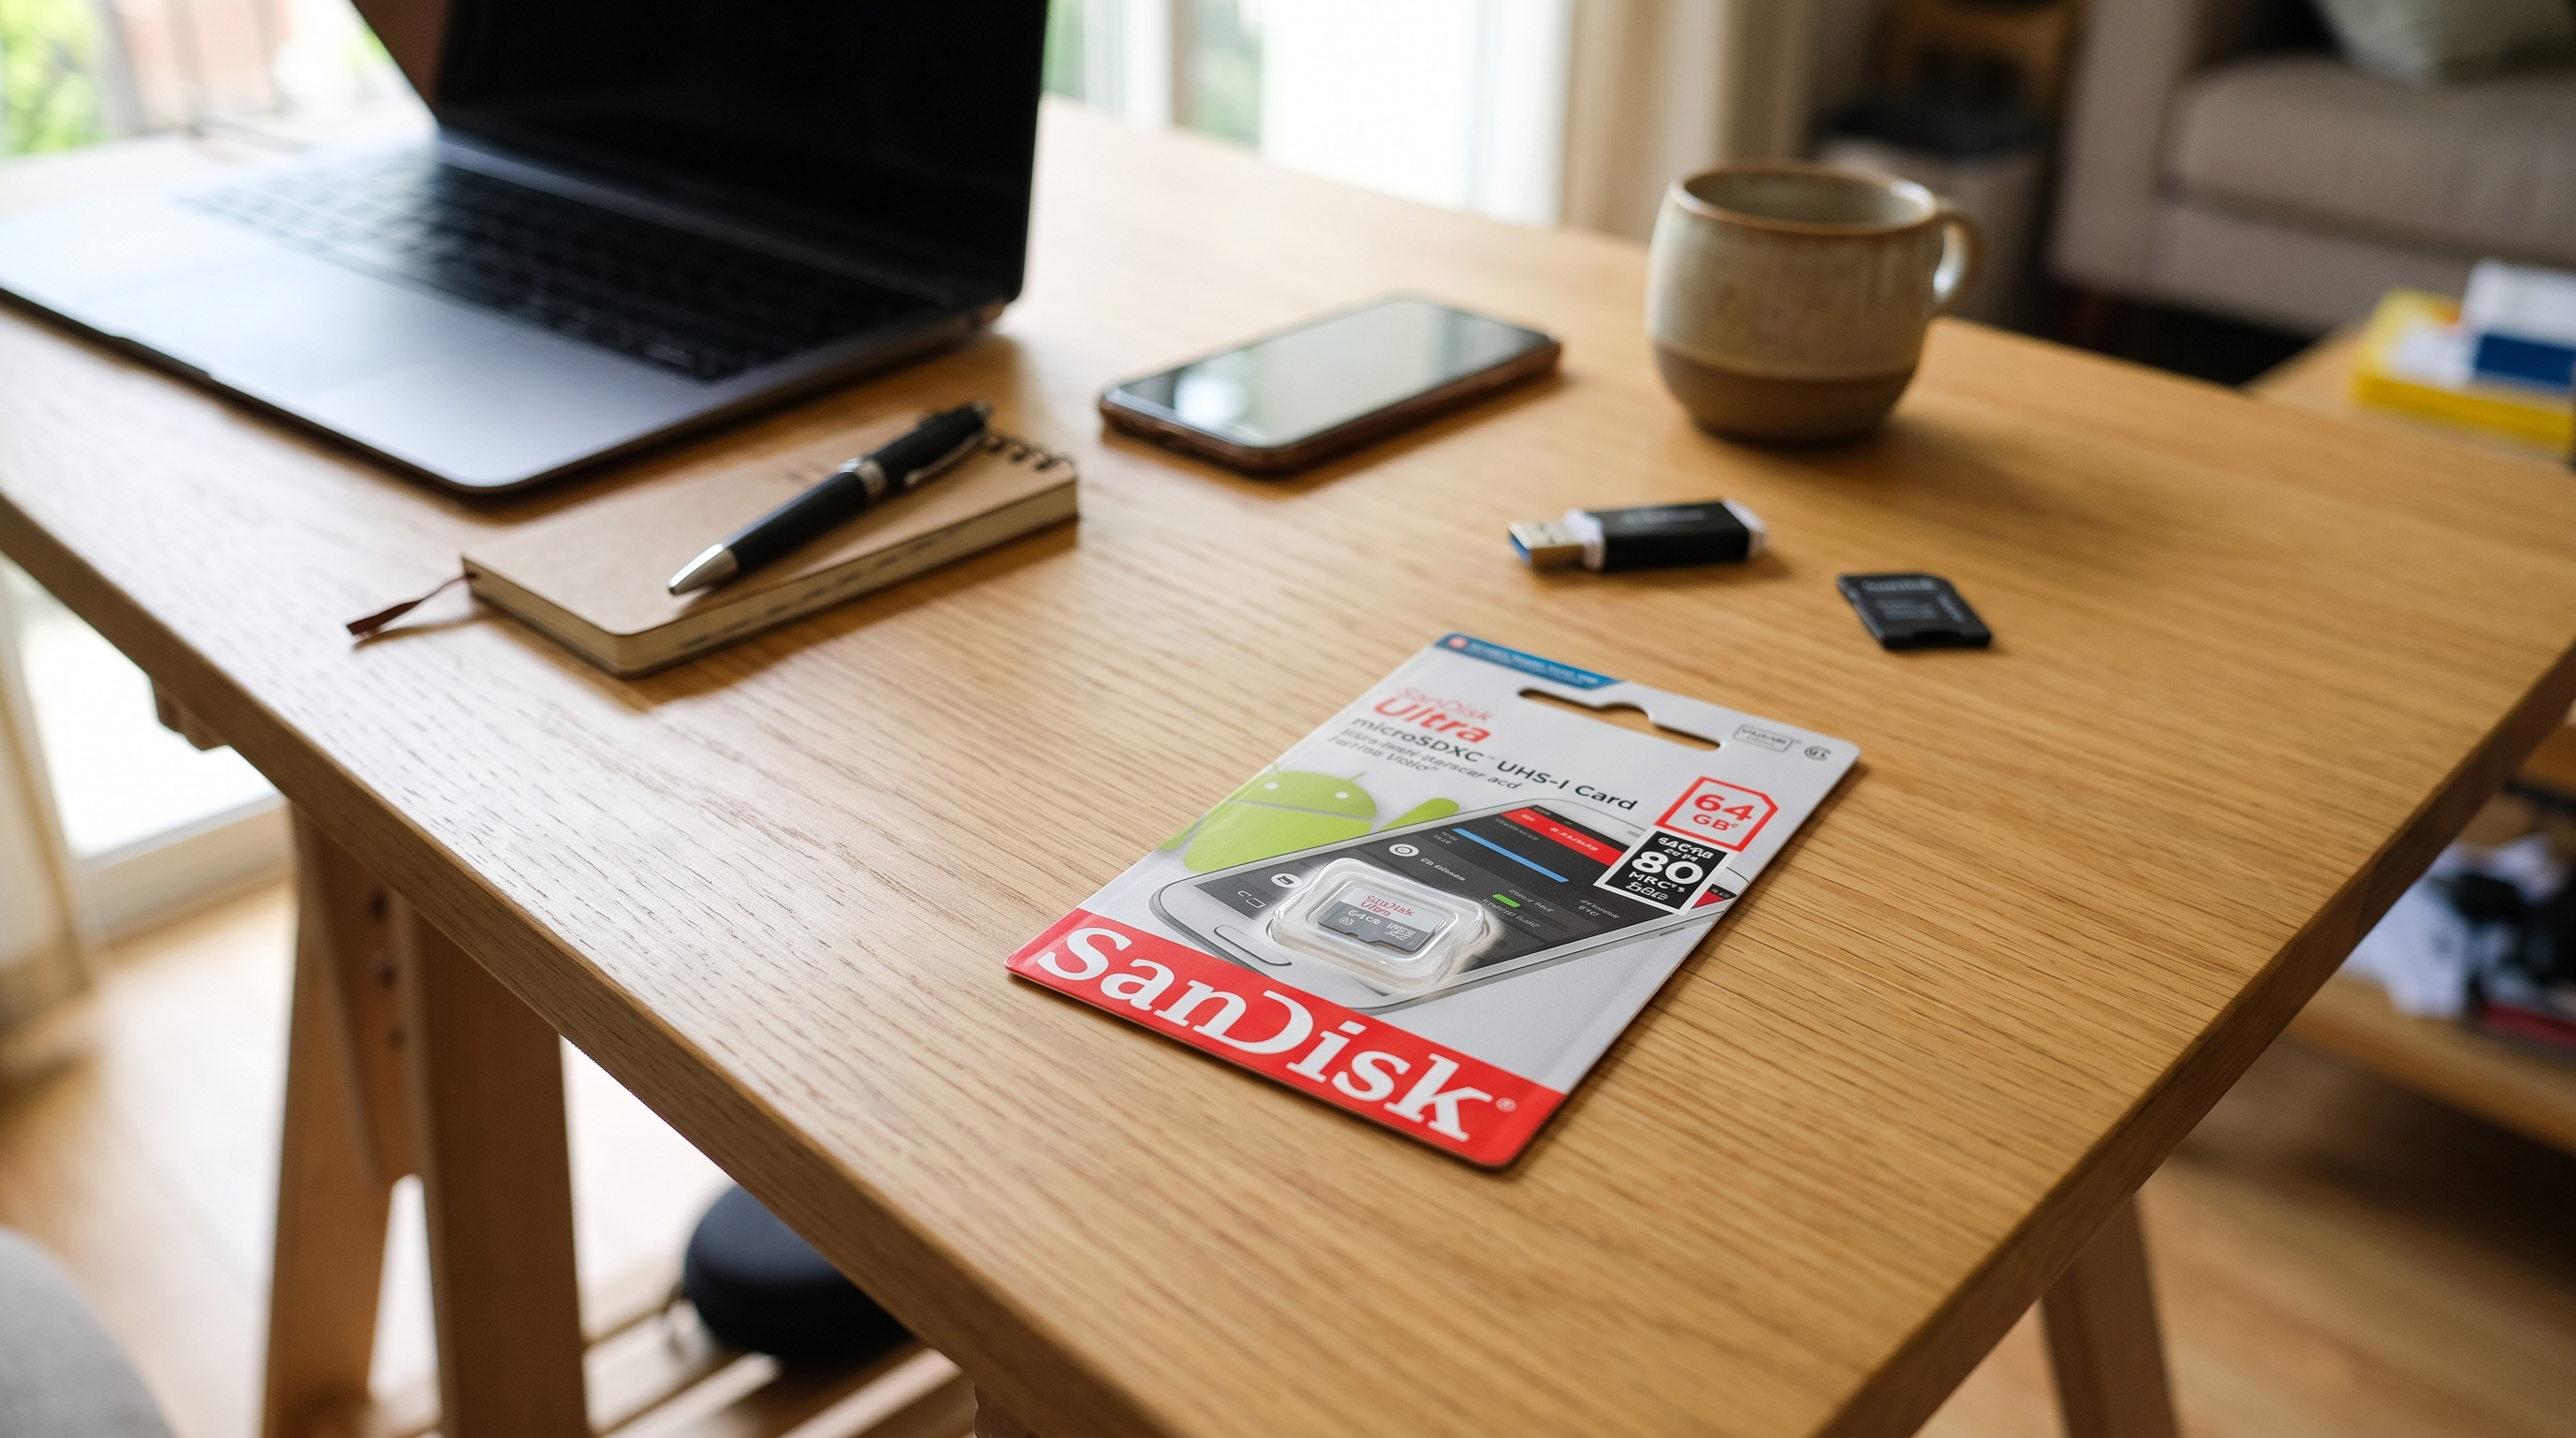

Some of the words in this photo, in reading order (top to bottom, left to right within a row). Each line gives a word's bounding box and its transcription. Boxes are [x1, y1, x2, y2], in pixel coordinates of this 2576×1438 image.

[1374, 697, 1492, 743] Ultra
[1351, 718, 1485, 763] microSDXC
[1497, 760, 1570, 789] UHS-I
[1574, 785, 1639, 811] Card
[1694, 793, 1755, 822] 64
[1632, 851, 1704, 885] 80
